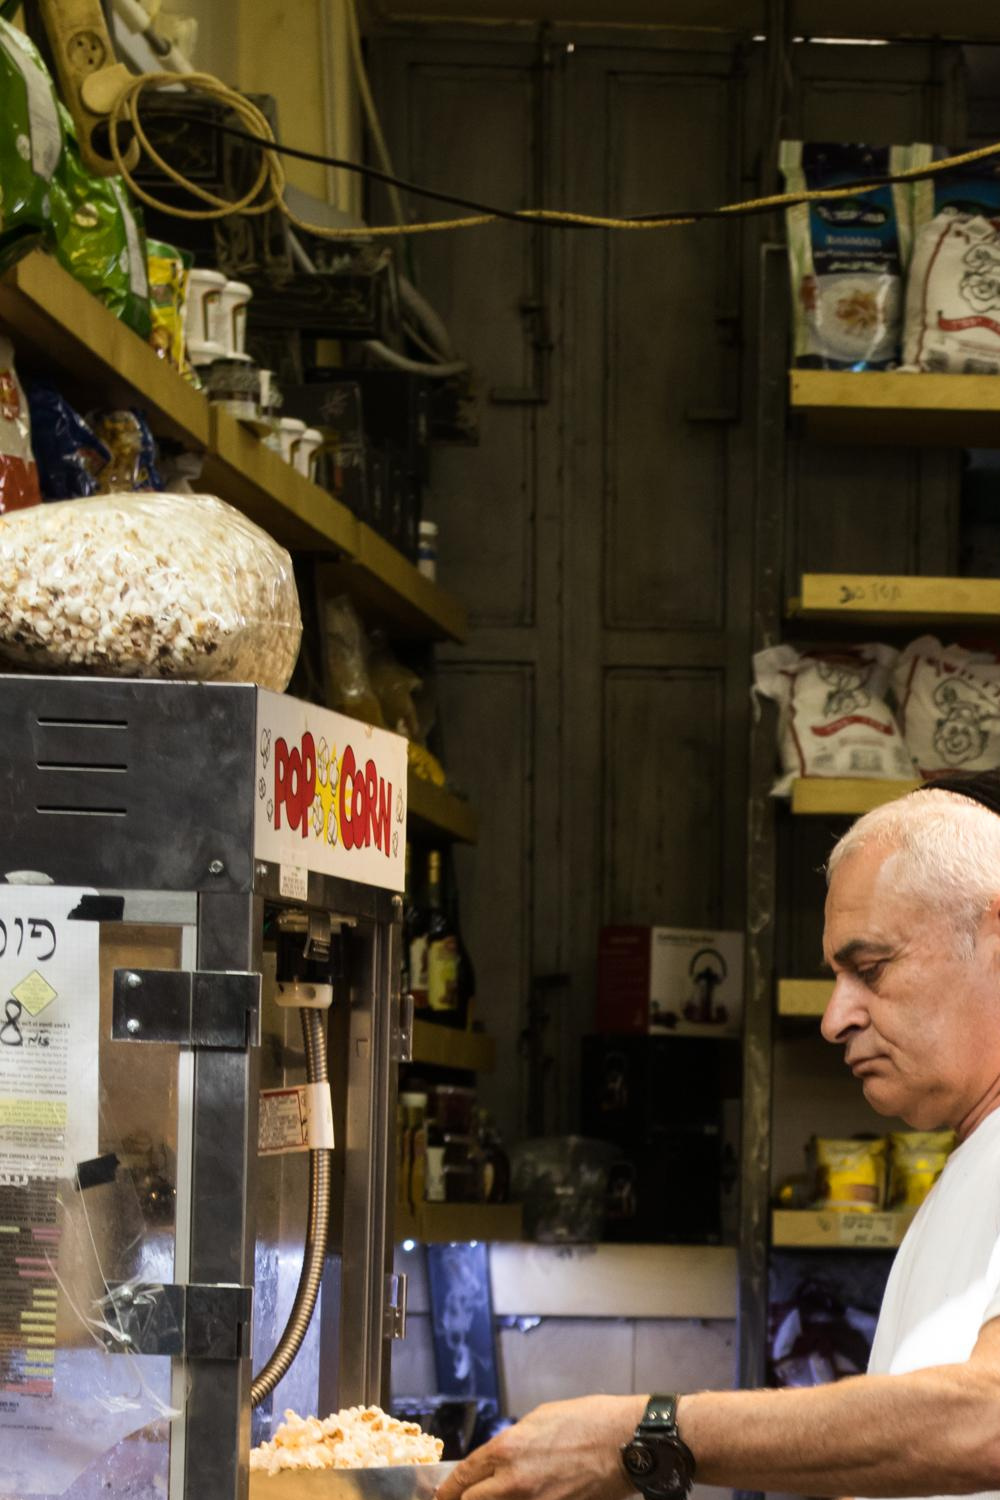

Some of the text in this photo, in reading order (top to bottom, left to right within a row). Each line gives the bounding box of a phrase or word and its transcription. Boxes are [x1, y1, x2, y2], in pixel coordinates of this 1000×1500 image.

[274, 731, 393, 858] POP CORN
[0, 998, 23, 1047] 8
